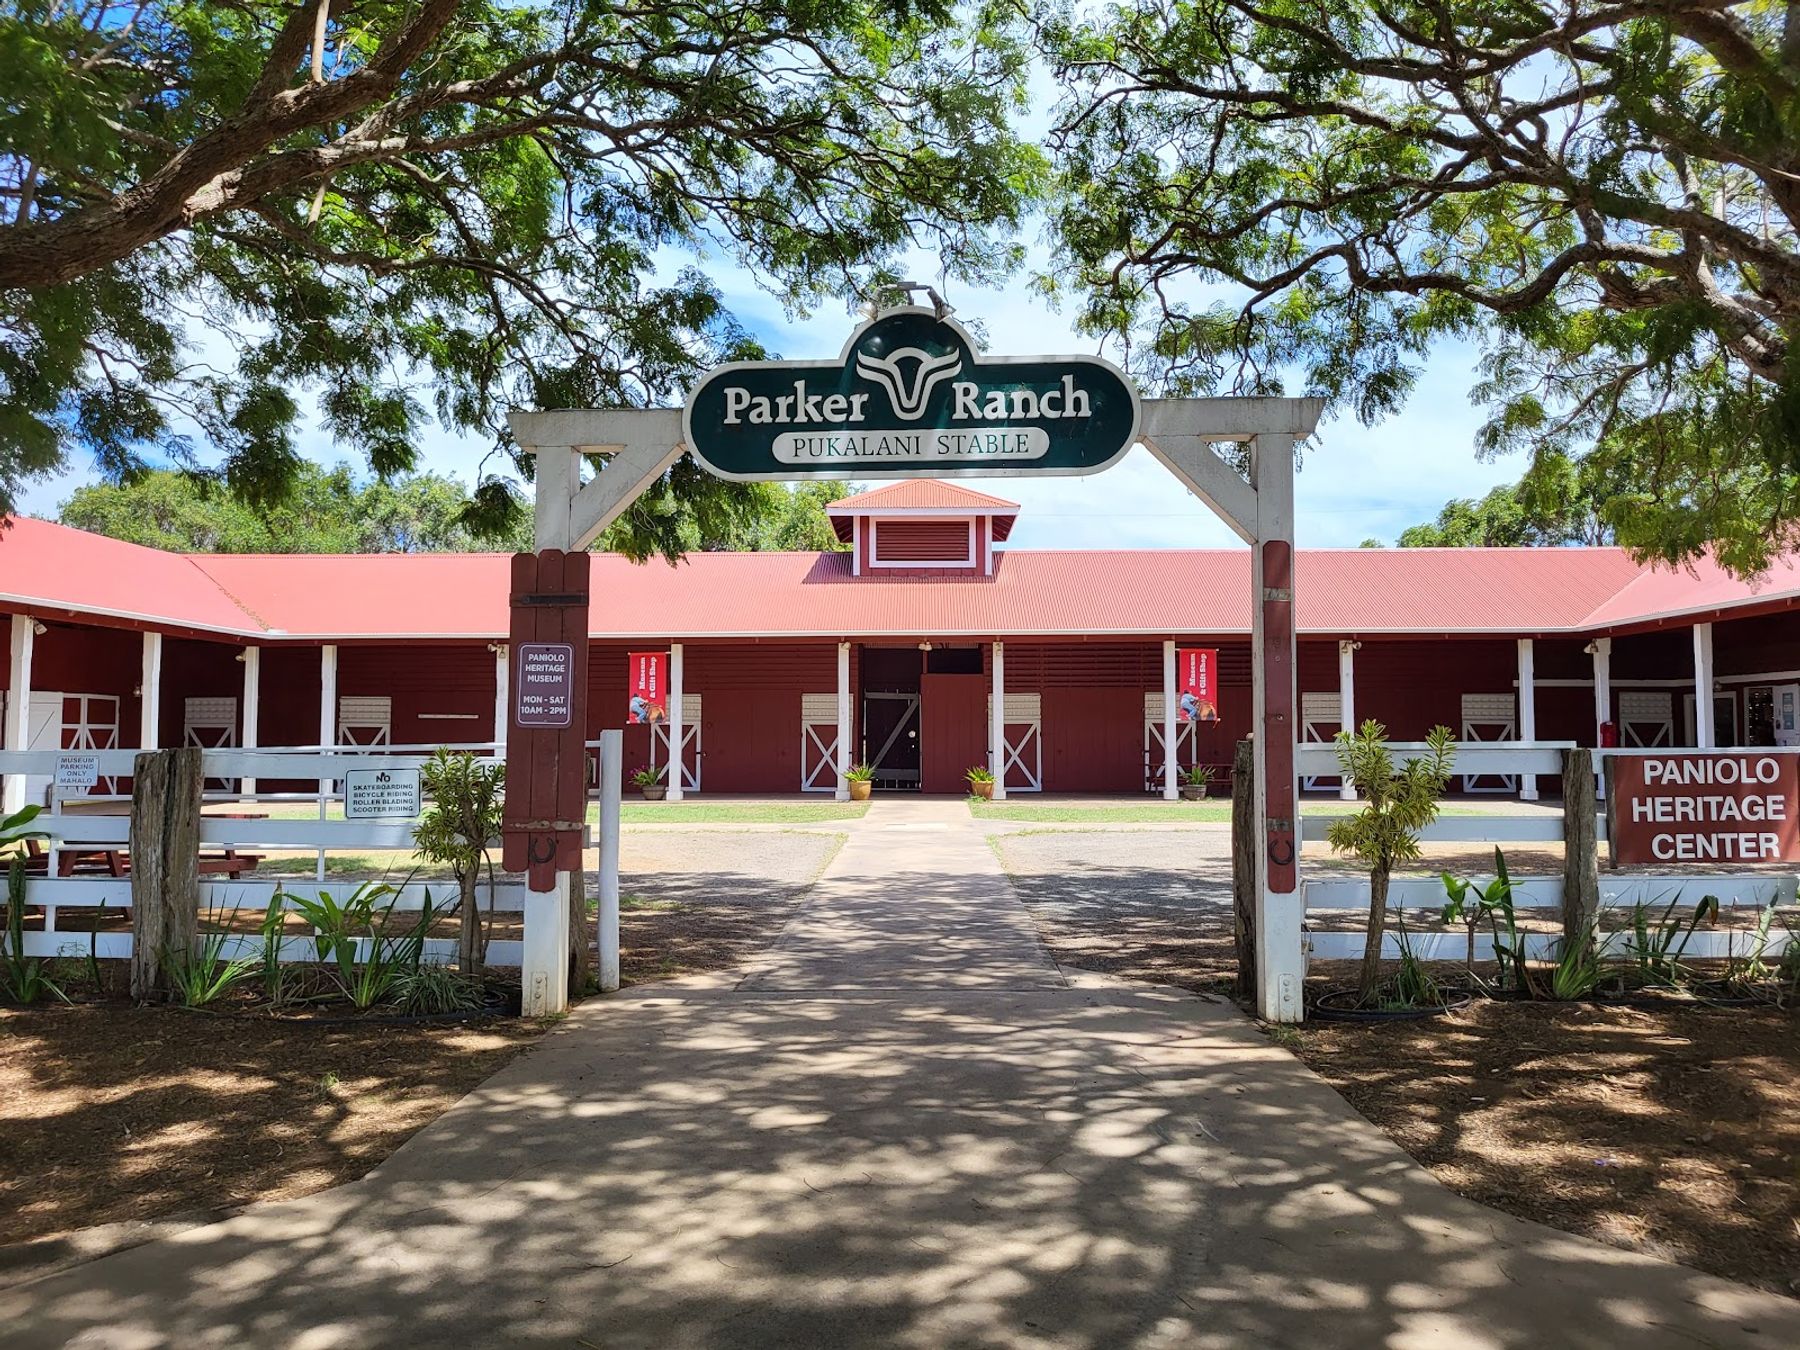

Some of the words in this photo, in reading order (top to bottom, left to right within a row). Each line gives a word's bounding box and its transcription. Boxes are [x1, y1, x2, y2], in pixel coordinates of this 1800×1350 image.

[723, 380, 869, 425] Parker
[951, 374, 1092, 420] Ranch
[792, 435, 920, 457] PUKALANI
[936, 433, 1029, 455] STABLE
[528, 653, 565, 662] PANIOLO
[525, 664, 566, 672] HERITAGE
[649, 656, 657, 676] Shop
[527, 674, 562, 683] MUSEUM
[523, 695, 543, 704] MON
[549, 696, 565, 704] SAT
[520, 706, 543, 714] 10AM
[549, 706, 567, 715] 2PM
[1643, 758, 1780, 785] PANIOLO
[375, 775, 391, 783] NO
[1632, 795, 1786, 822] HERITAGE
[1651, 832, 1780, 860] CENTER
